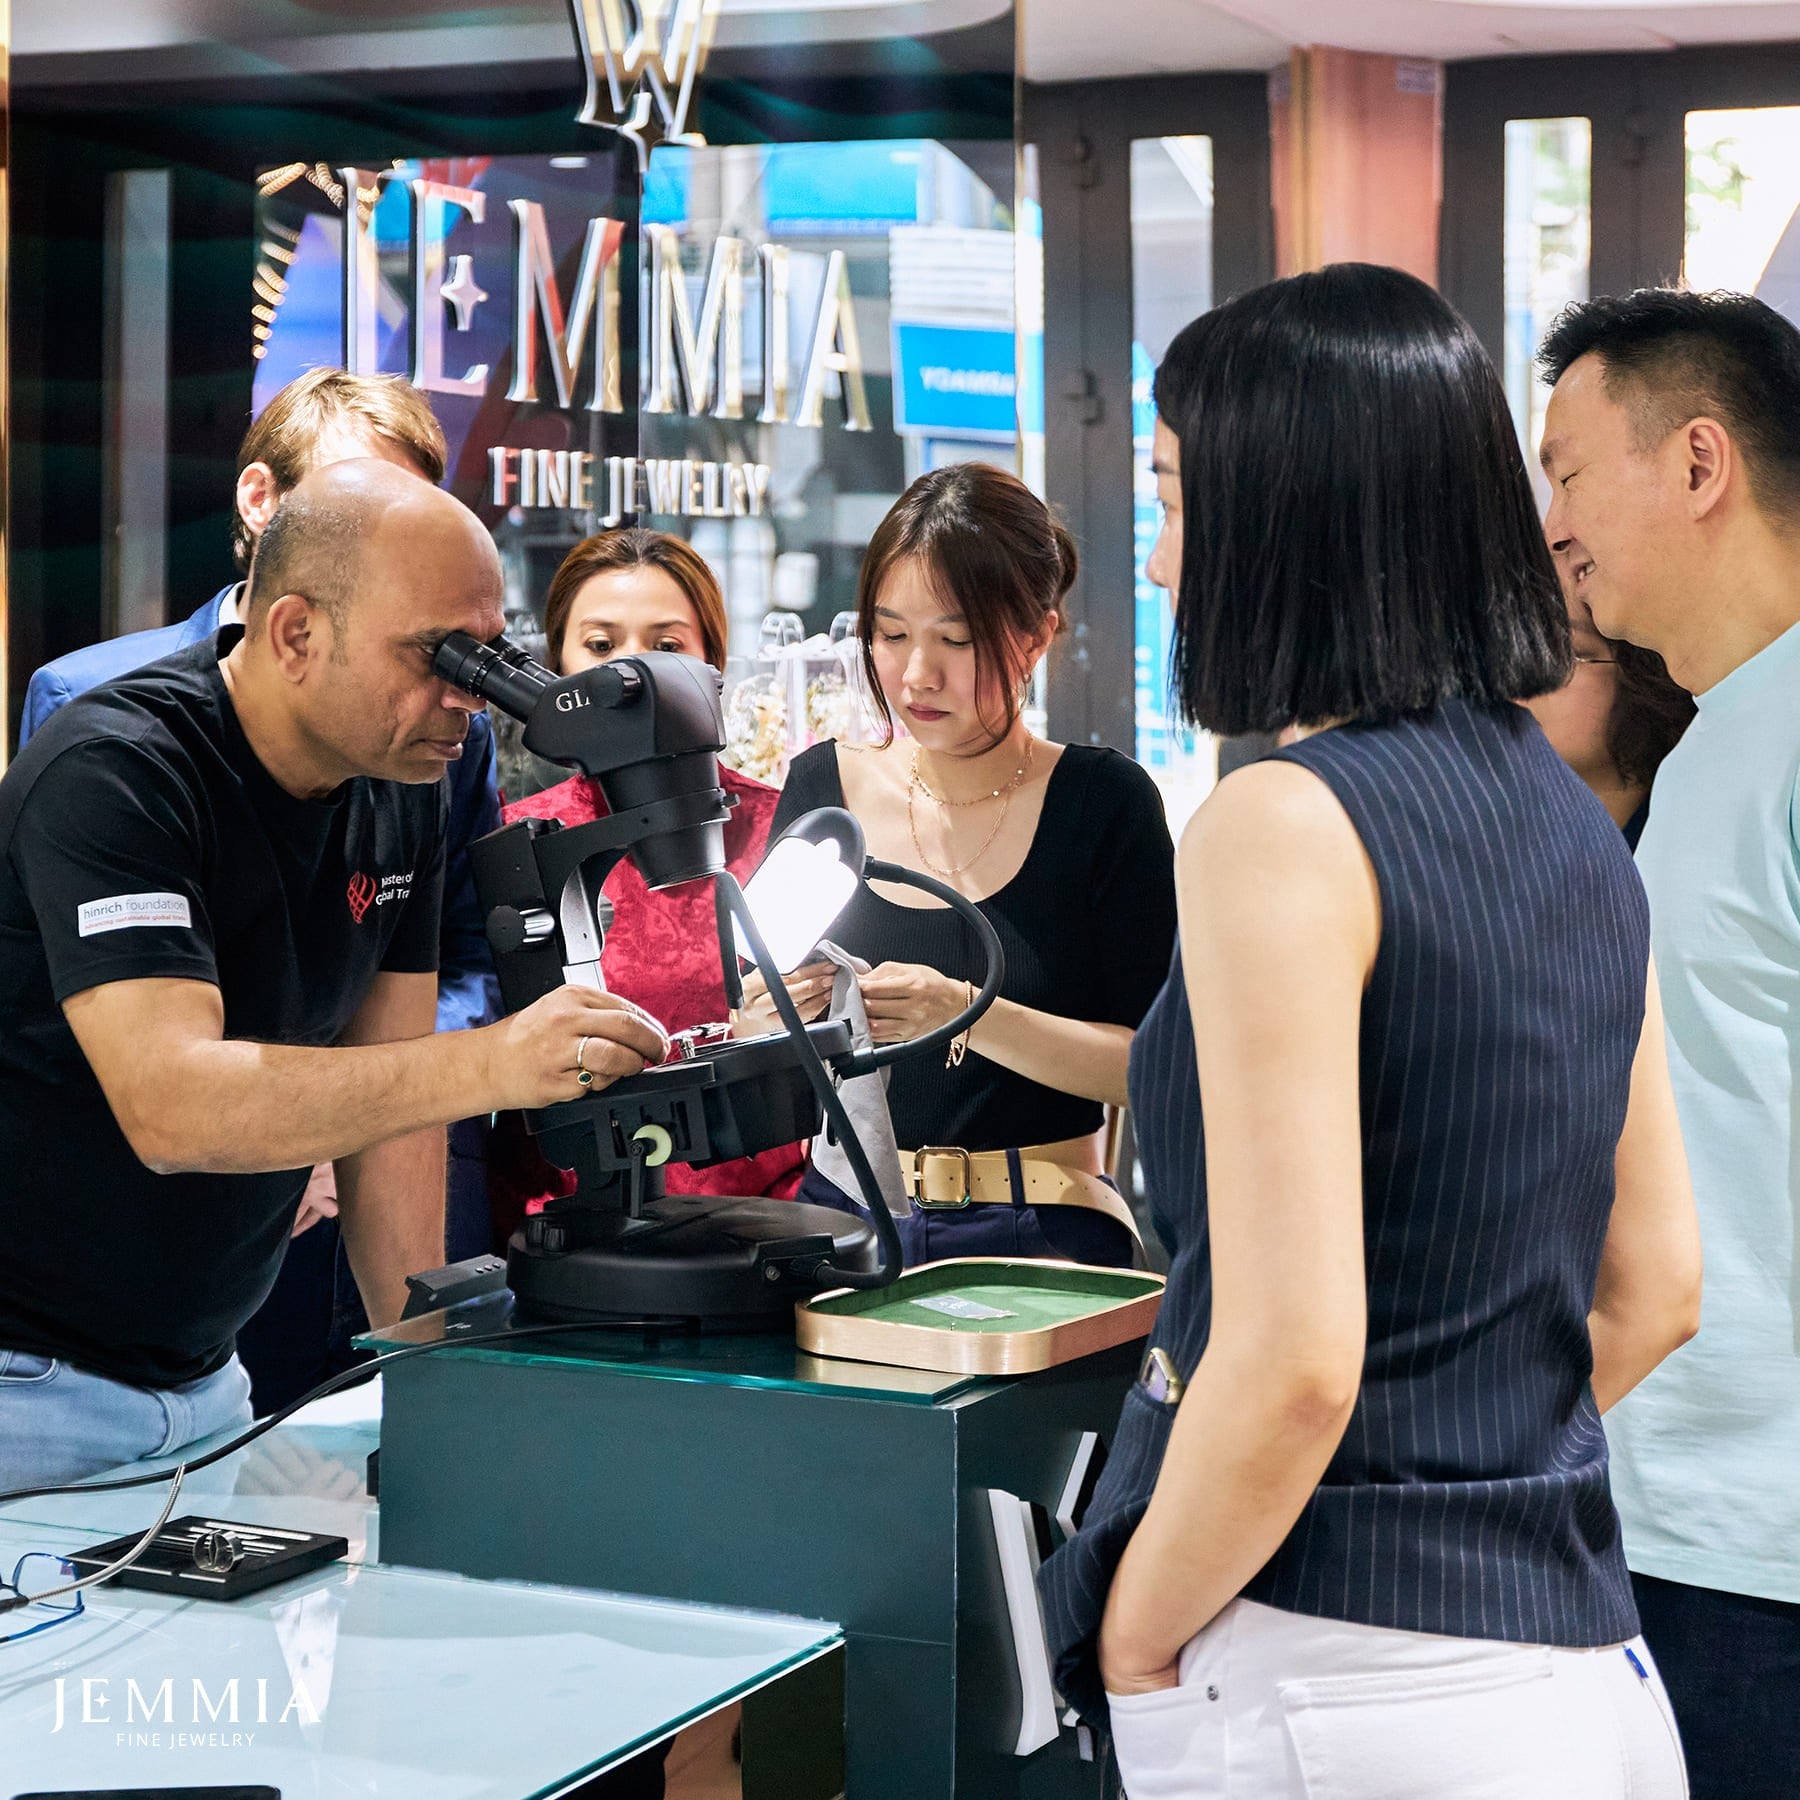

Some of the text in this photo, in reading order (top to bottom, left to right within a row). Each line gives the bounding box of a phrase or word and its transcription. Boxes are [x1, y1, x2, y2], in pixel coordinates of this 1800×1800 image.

[489, 446, 770, 527] FINE JEWELRY
[84, 898, 186, 919] hinrich foundation
